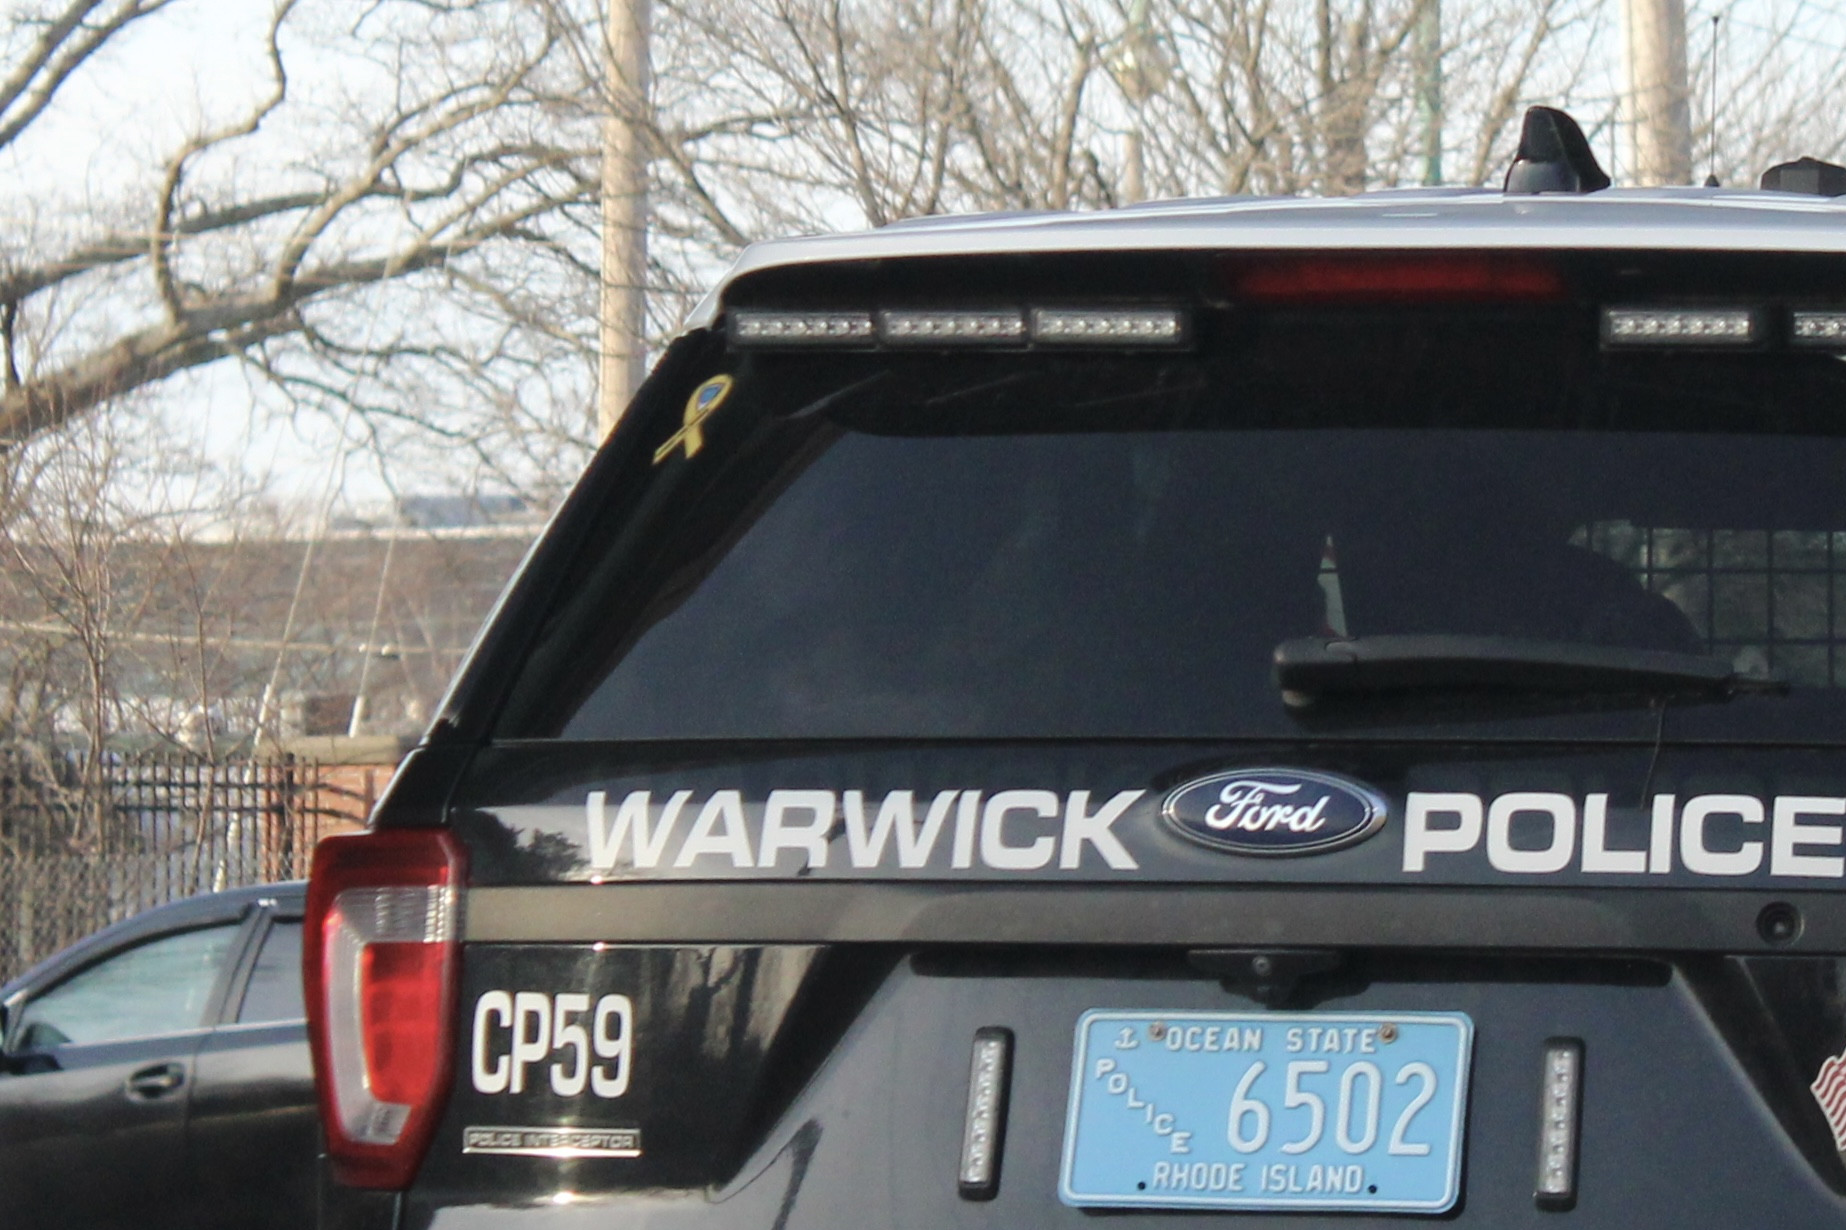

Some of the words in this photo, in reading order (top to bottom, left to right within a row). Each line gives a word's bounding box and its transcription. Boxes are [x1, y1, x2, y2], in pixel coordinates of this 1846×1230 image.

[586, 788, 1146, 871] WARWICK
[1204, 780, 1328, 833] Ford
[471, 989, 633, 1098] CP59
[1164, 1026, 1263, 1052] OCEAN
[1285, 1027, 1377, 1054] STATE
[468, 1133, 522, 1147] POLICE
[1094, 1058, 1192, 1155] POLICE
[1226, 1059, 1439, 1157] 6502
[1151, 1161, 1246, 1192] RHODE
[1260, 1164, 1364, 1195] ISLAND
